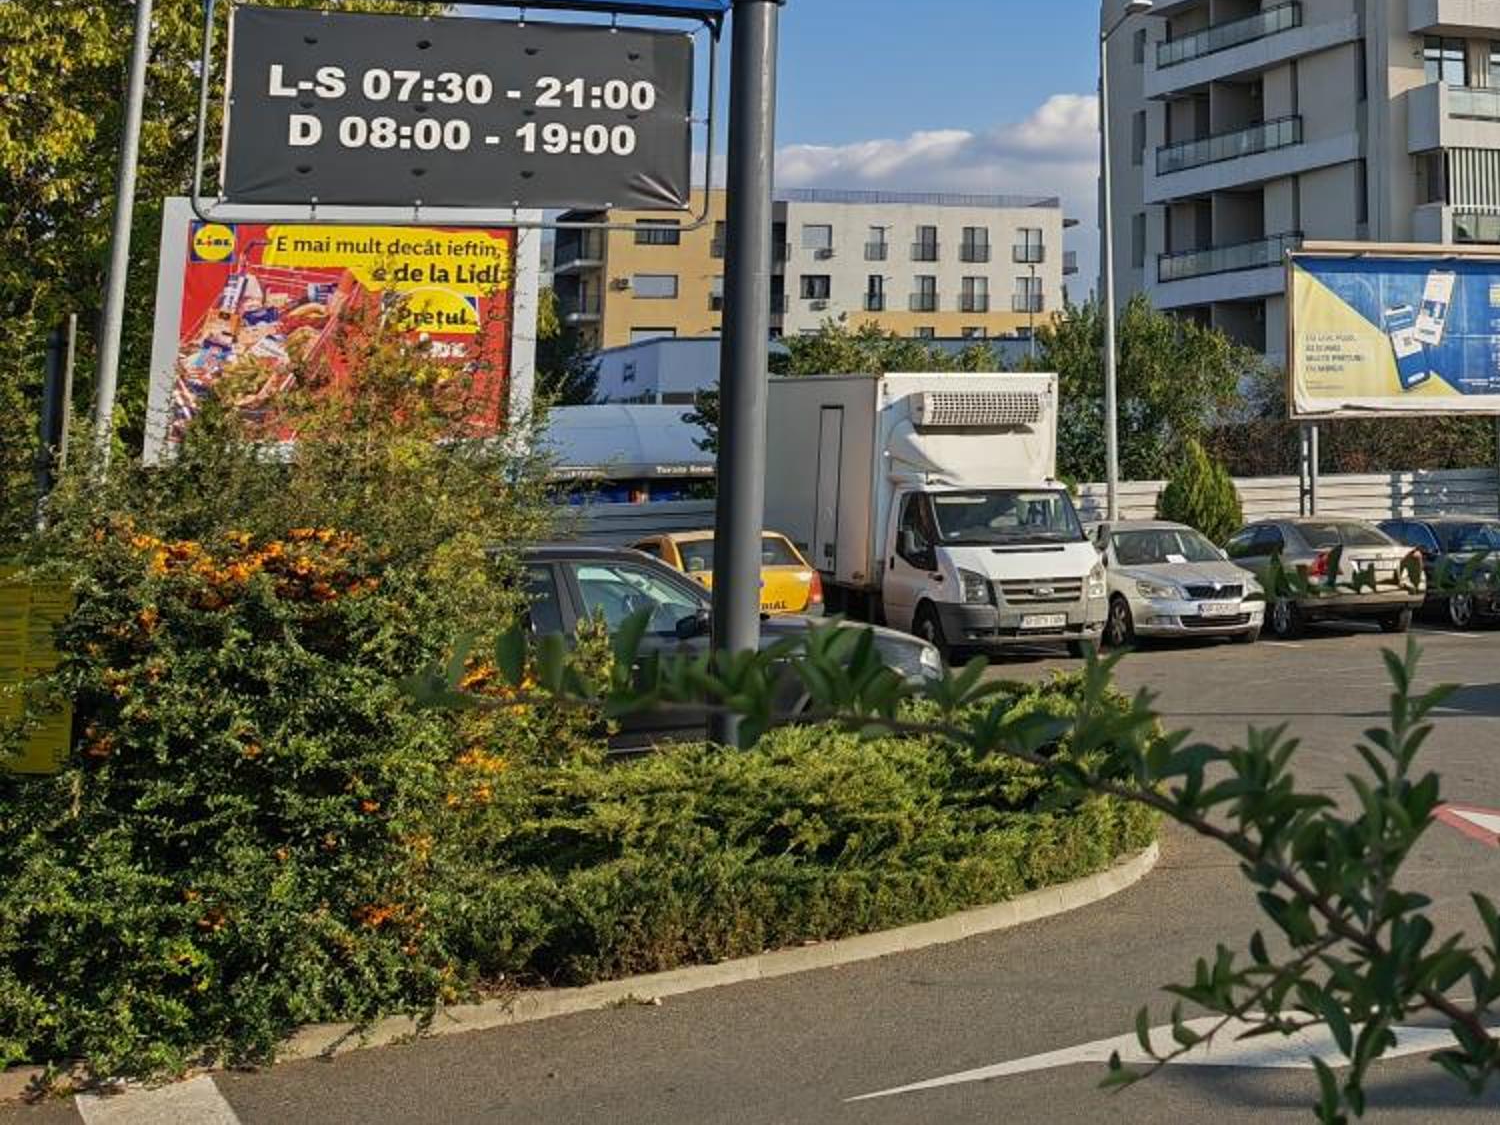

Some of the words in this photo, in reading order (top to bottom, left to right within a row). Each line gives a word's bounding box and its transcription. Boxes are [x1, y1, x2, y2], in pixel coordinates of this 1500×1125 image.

[268, 64, 347, 99] L-S
[362, 68, 493, 104] 07:30
[534, 76, 656, 111] 21:00
[288, 114, 323, 147] D
[338, 116, 471, 151] 08:00
[515, 122, 637, 156] 19:00
[276, 236, 288, 252] E
[293, 236, 331, 253] mai
[336, 237, 382, 254] mult
[394, 263, 423, 282] de
[429, 263, 449, 283] la
